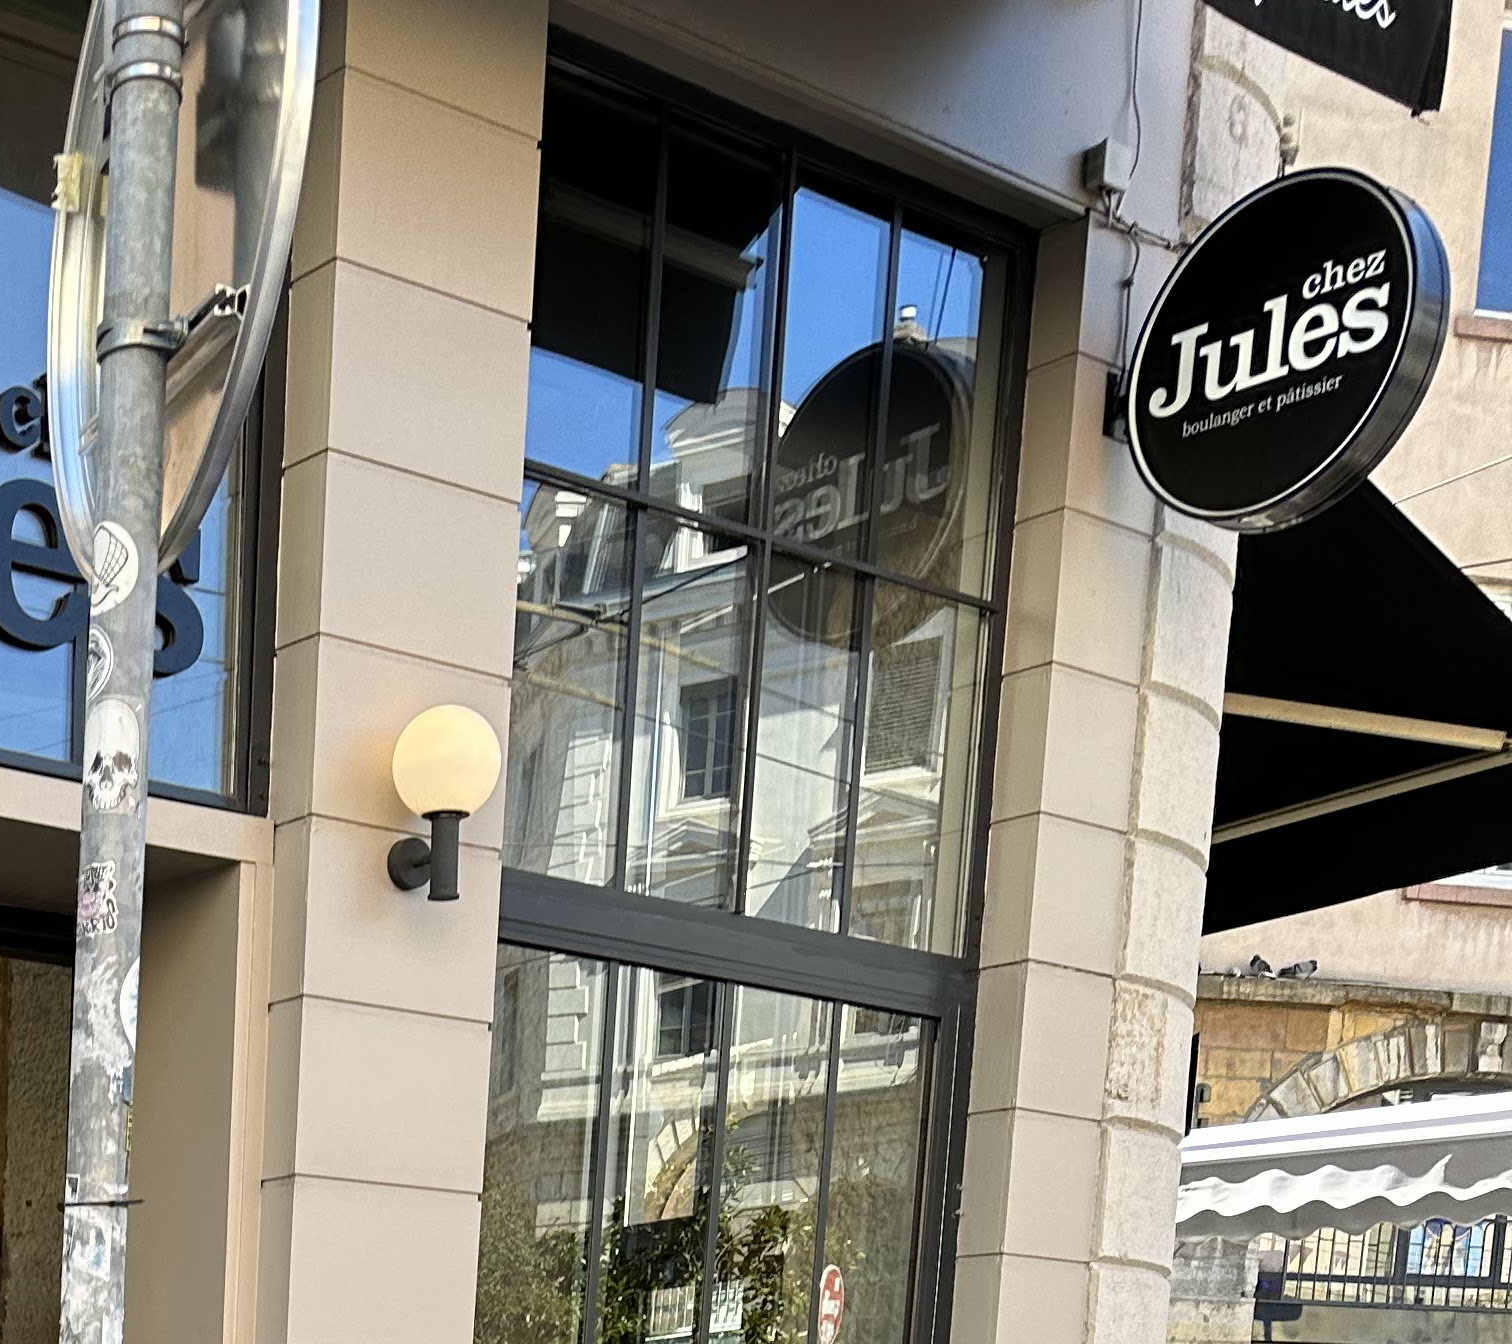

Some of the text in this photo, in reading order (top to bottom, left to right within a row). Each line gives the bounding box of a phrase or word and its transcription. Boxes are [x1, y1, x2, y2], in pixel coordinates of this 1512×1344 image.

[1302, 249, 1387, 300] chez
[1148, 282, 1391, 419] Jules
[1182, 374, 1343, 438] boulanger et pâtissier
